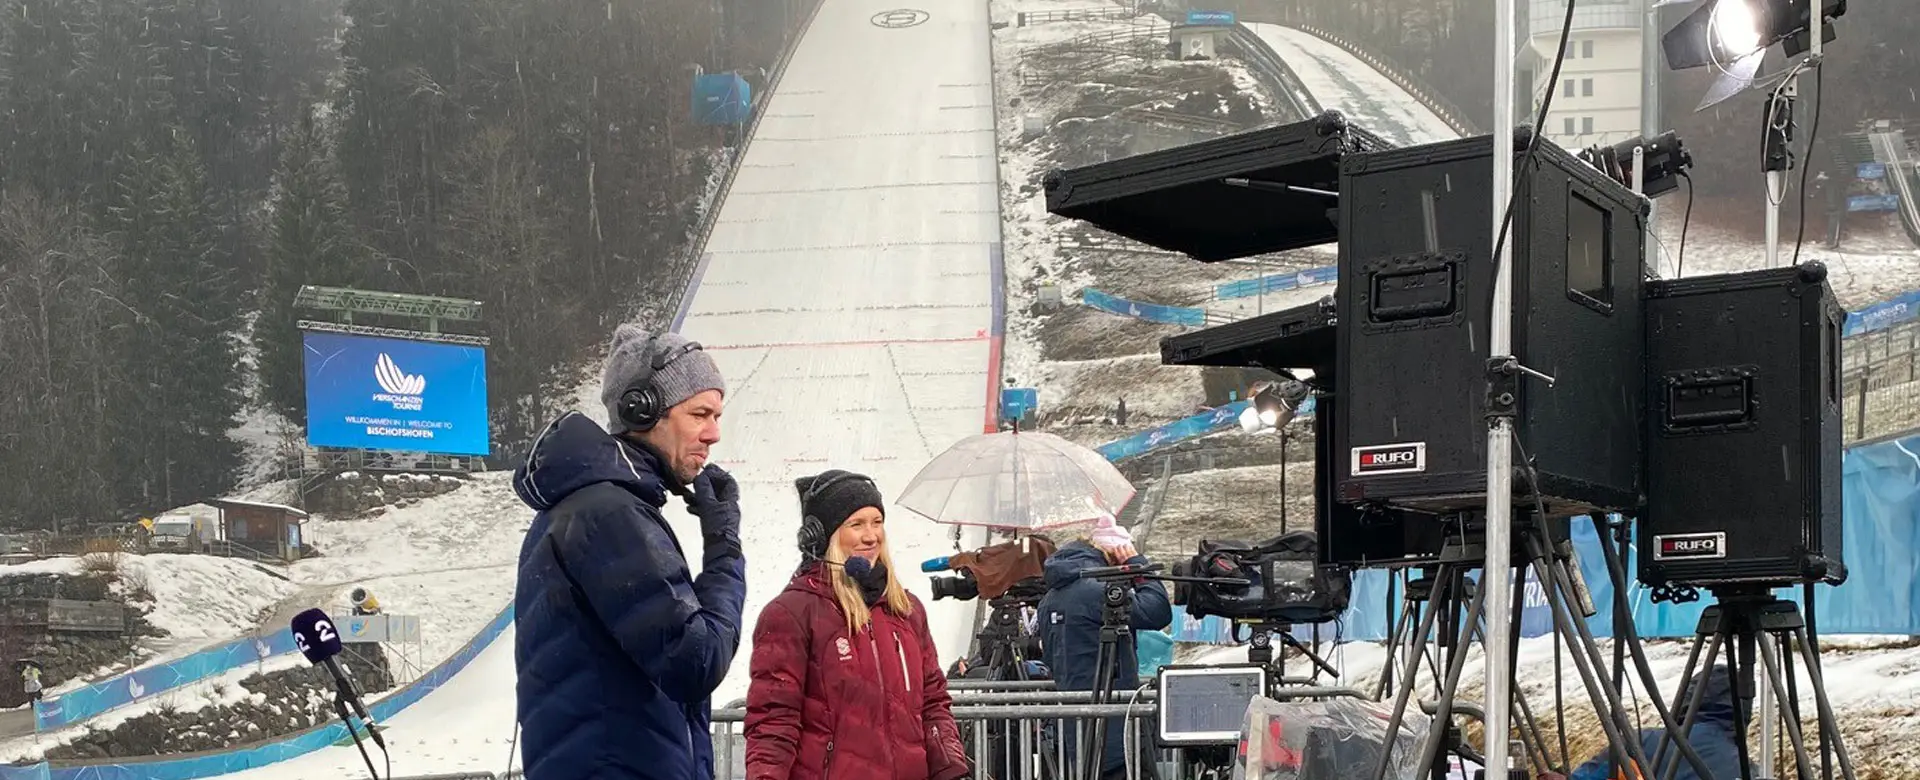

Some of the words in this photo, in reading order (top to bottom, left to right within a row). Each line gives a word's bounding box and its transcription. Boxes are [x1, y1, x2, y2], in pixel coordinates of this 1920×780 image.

[344, 416, 391, 425] WILLKOMMEN
[408, 420, 443, 428] WELCOME
[366, 427, 434, 438] BISCHOFSHOFEN
[1372, 451, 1415, 464] RUFO
[1674, 539, 1715, 550] RUFO
[315, 620, 336, 642] 2
